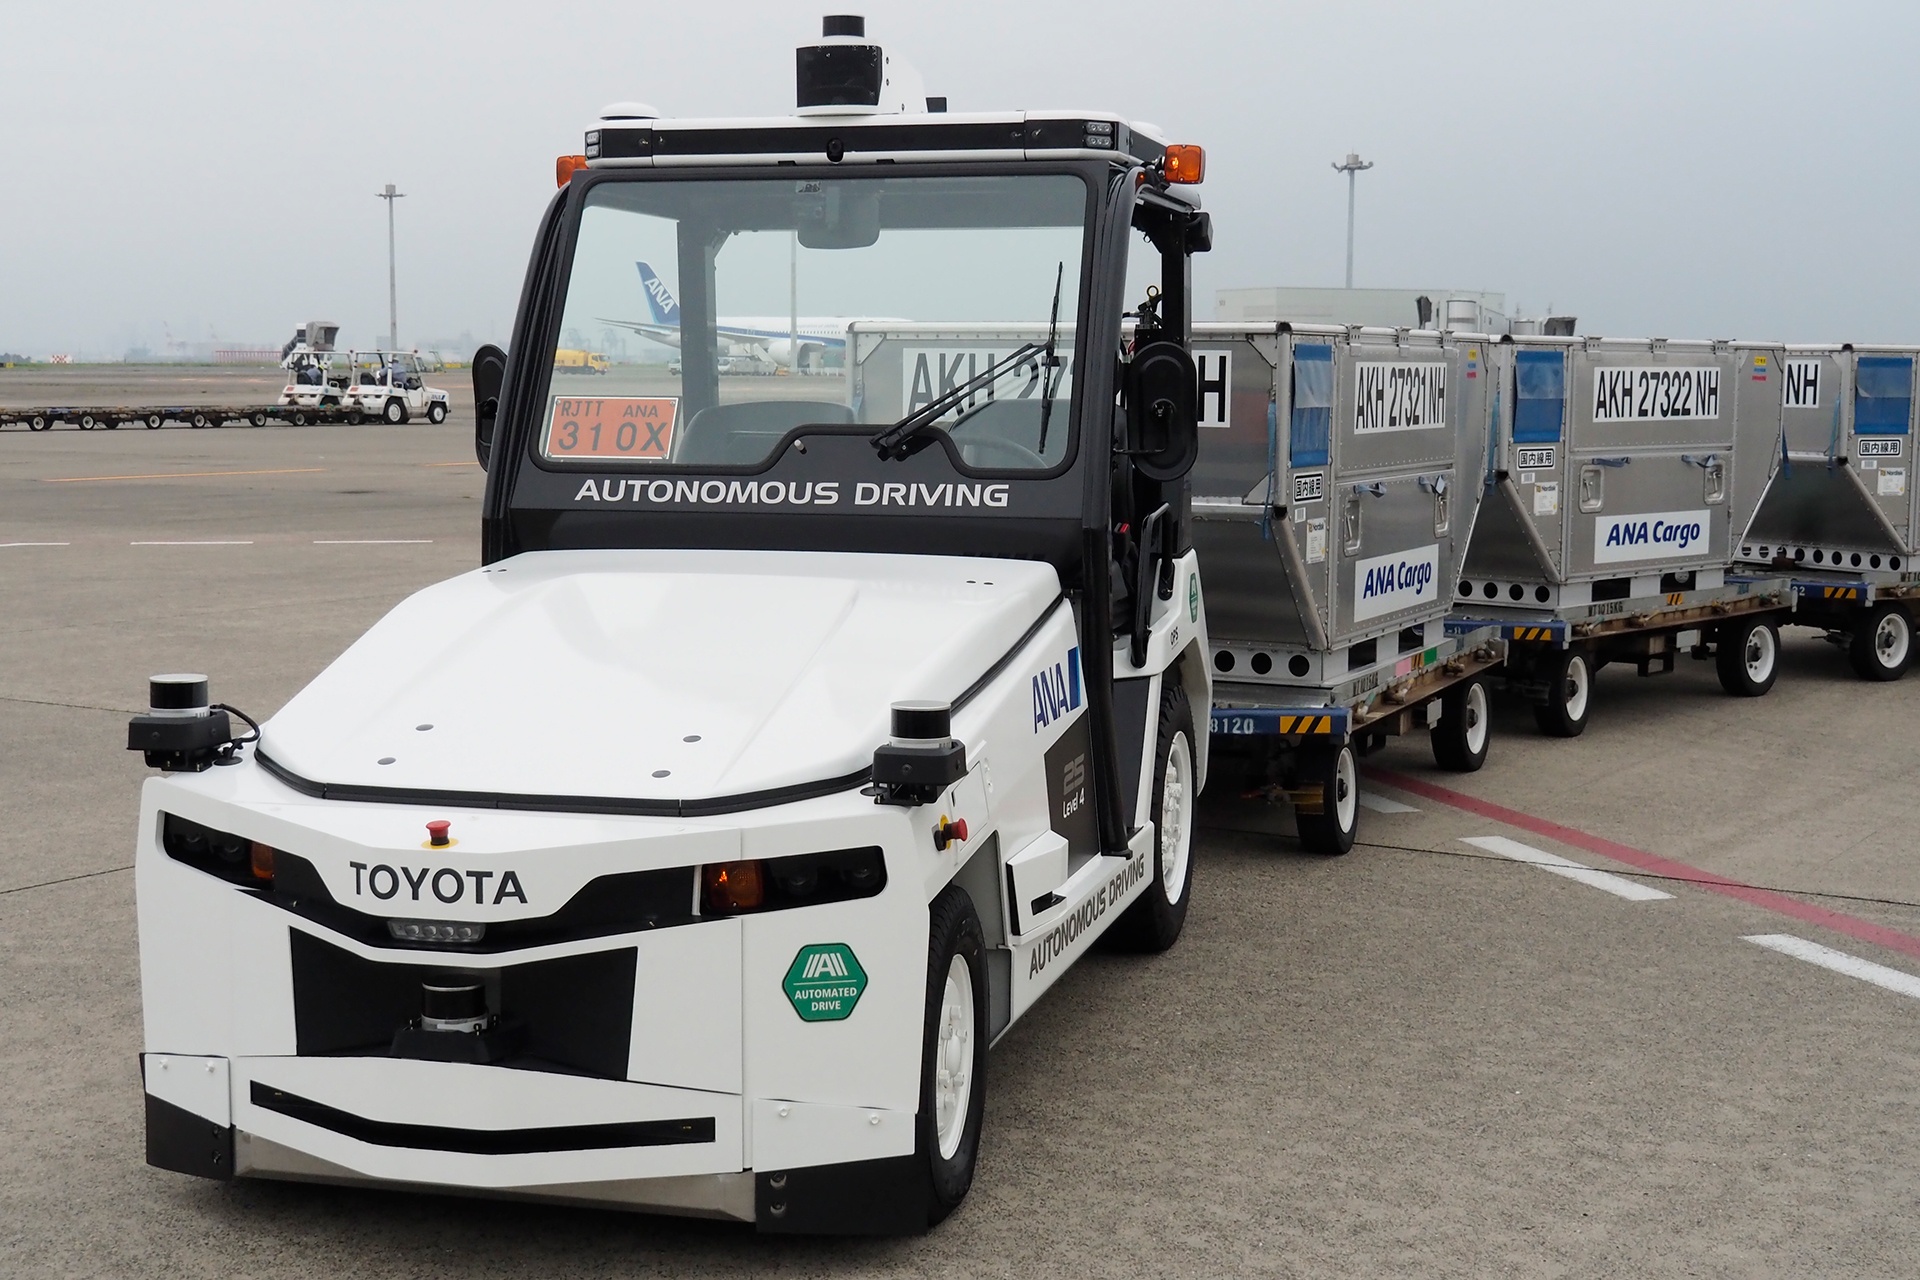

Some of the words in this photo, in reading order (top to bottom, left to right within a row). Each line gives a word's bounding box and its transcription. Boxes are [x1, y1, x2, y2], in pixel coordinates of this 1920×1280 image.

[644, 277, 676, 315] ANA
[1355, 366, 1385, 429] AKH
[1388, 366, 1427, 428] 27321
[1428, 366, 1446, 425] NH
[1595, 370, 1634, 419] AKH
[1637, 370, 1693, 418] 27322
[1695, 370, 1720, 416] NH
[1785, 363, 1819, 405] NH
[560, 400, 605, 417] RJTT
[622, 404, 659, 418] ANA
[1520, 451, 1552, 466] 国内線用
[1860, 442, 1898, 453] 国内線用
[575, 478, 840, 505] AUTONOMOUS
[854, 481, 1010, 507] DRIVING
[1605, 521, 1649, 547] ANA
[1652, 520, 1701, 549] Cargo
[1362, 563, 1395, 600] ANA
[1397, 561, 1432, 595] Cargo
[1031, 662, 1070, 735] ANA
[1064, 752, 1085, 797] 25
[1063, 791, 1079, 819] Level
[1079, 787, 1085, 806] 4
[349, 860, 529, 905] TOYOTA
[1028, 886, 1107, 981] AUTONOMOUS
[1108, 852, 1145, 908] DRIVING
[794, 986, 858, 1000] AUTOMATED
[811, 1000, 842, 1012] DRIVE
